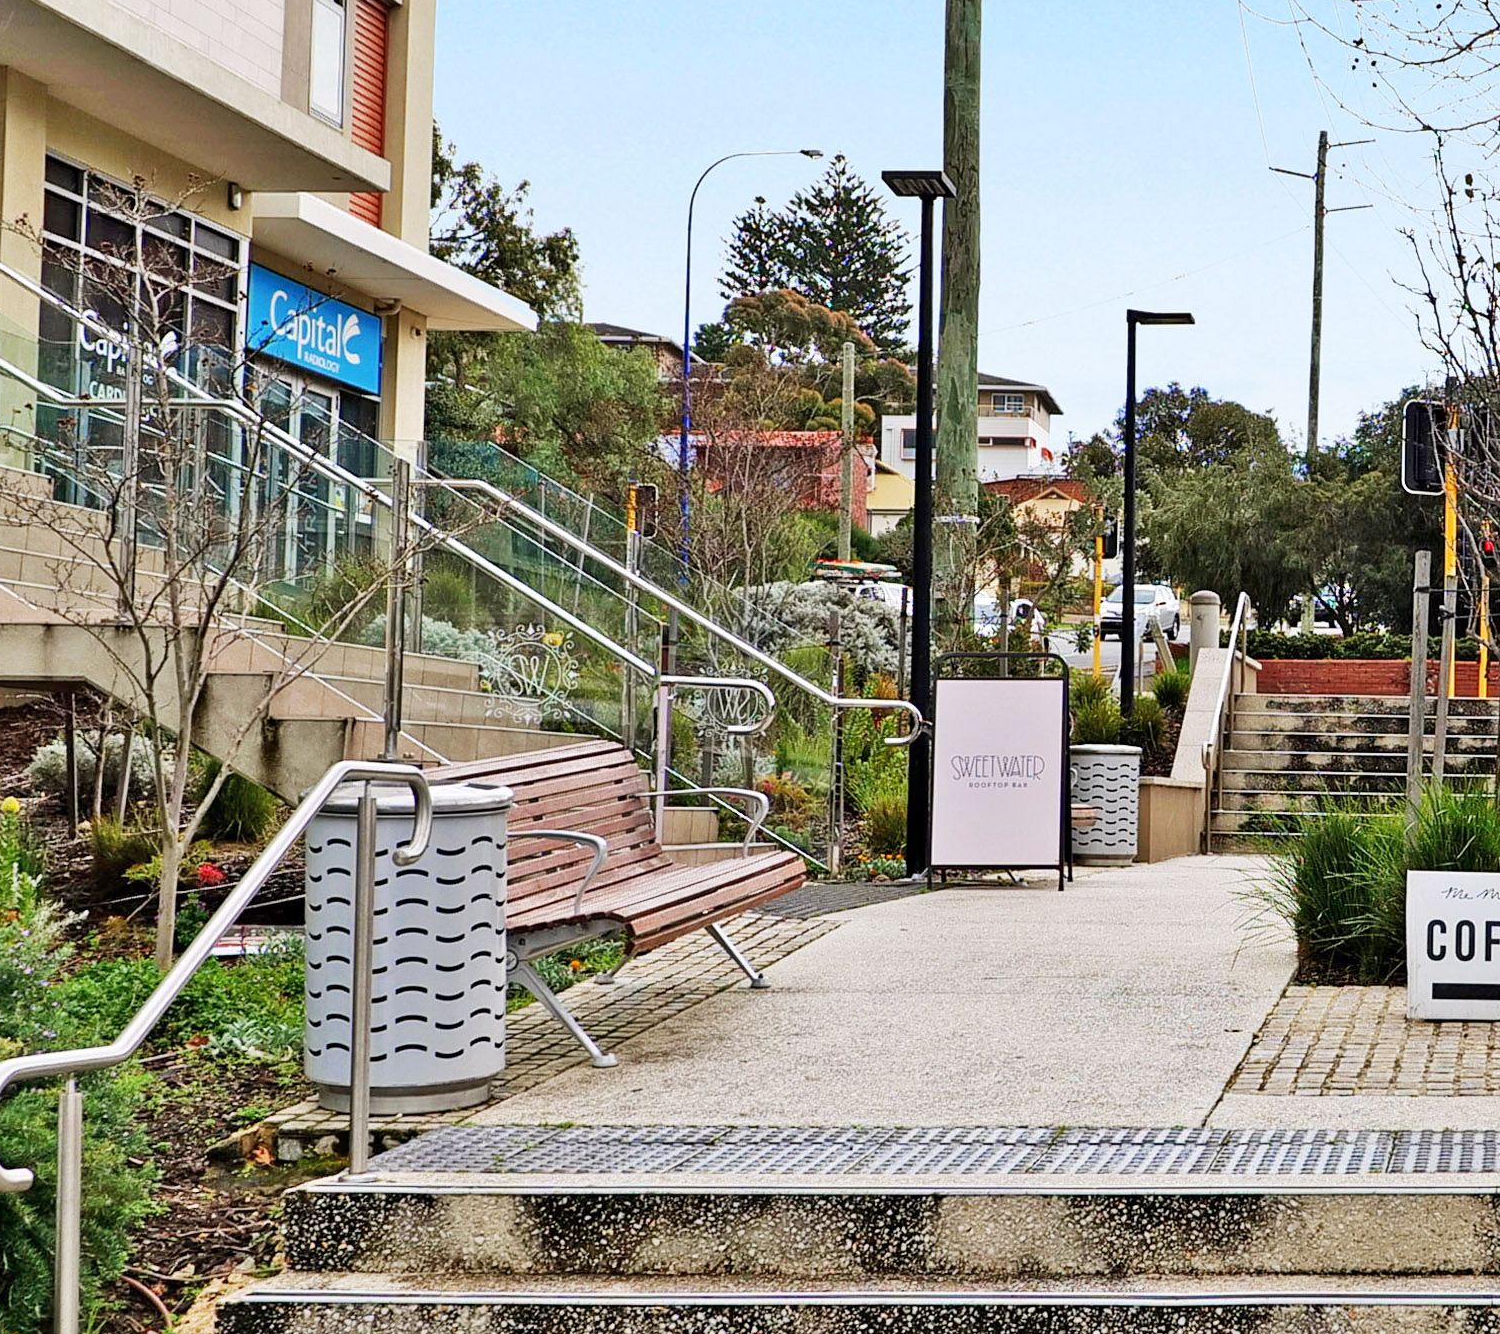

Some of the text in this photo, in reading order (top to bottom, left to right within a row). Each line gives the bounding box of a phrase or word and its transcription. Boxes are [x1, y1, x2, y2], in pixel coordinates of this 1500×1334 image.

[270, 290, 341, 360] Capital
[304, 352, 341, 374] RADIOLOGY
[950, 754, 1045, 781] SWEETWATER
[1441, 886, 1474, 901] Me
